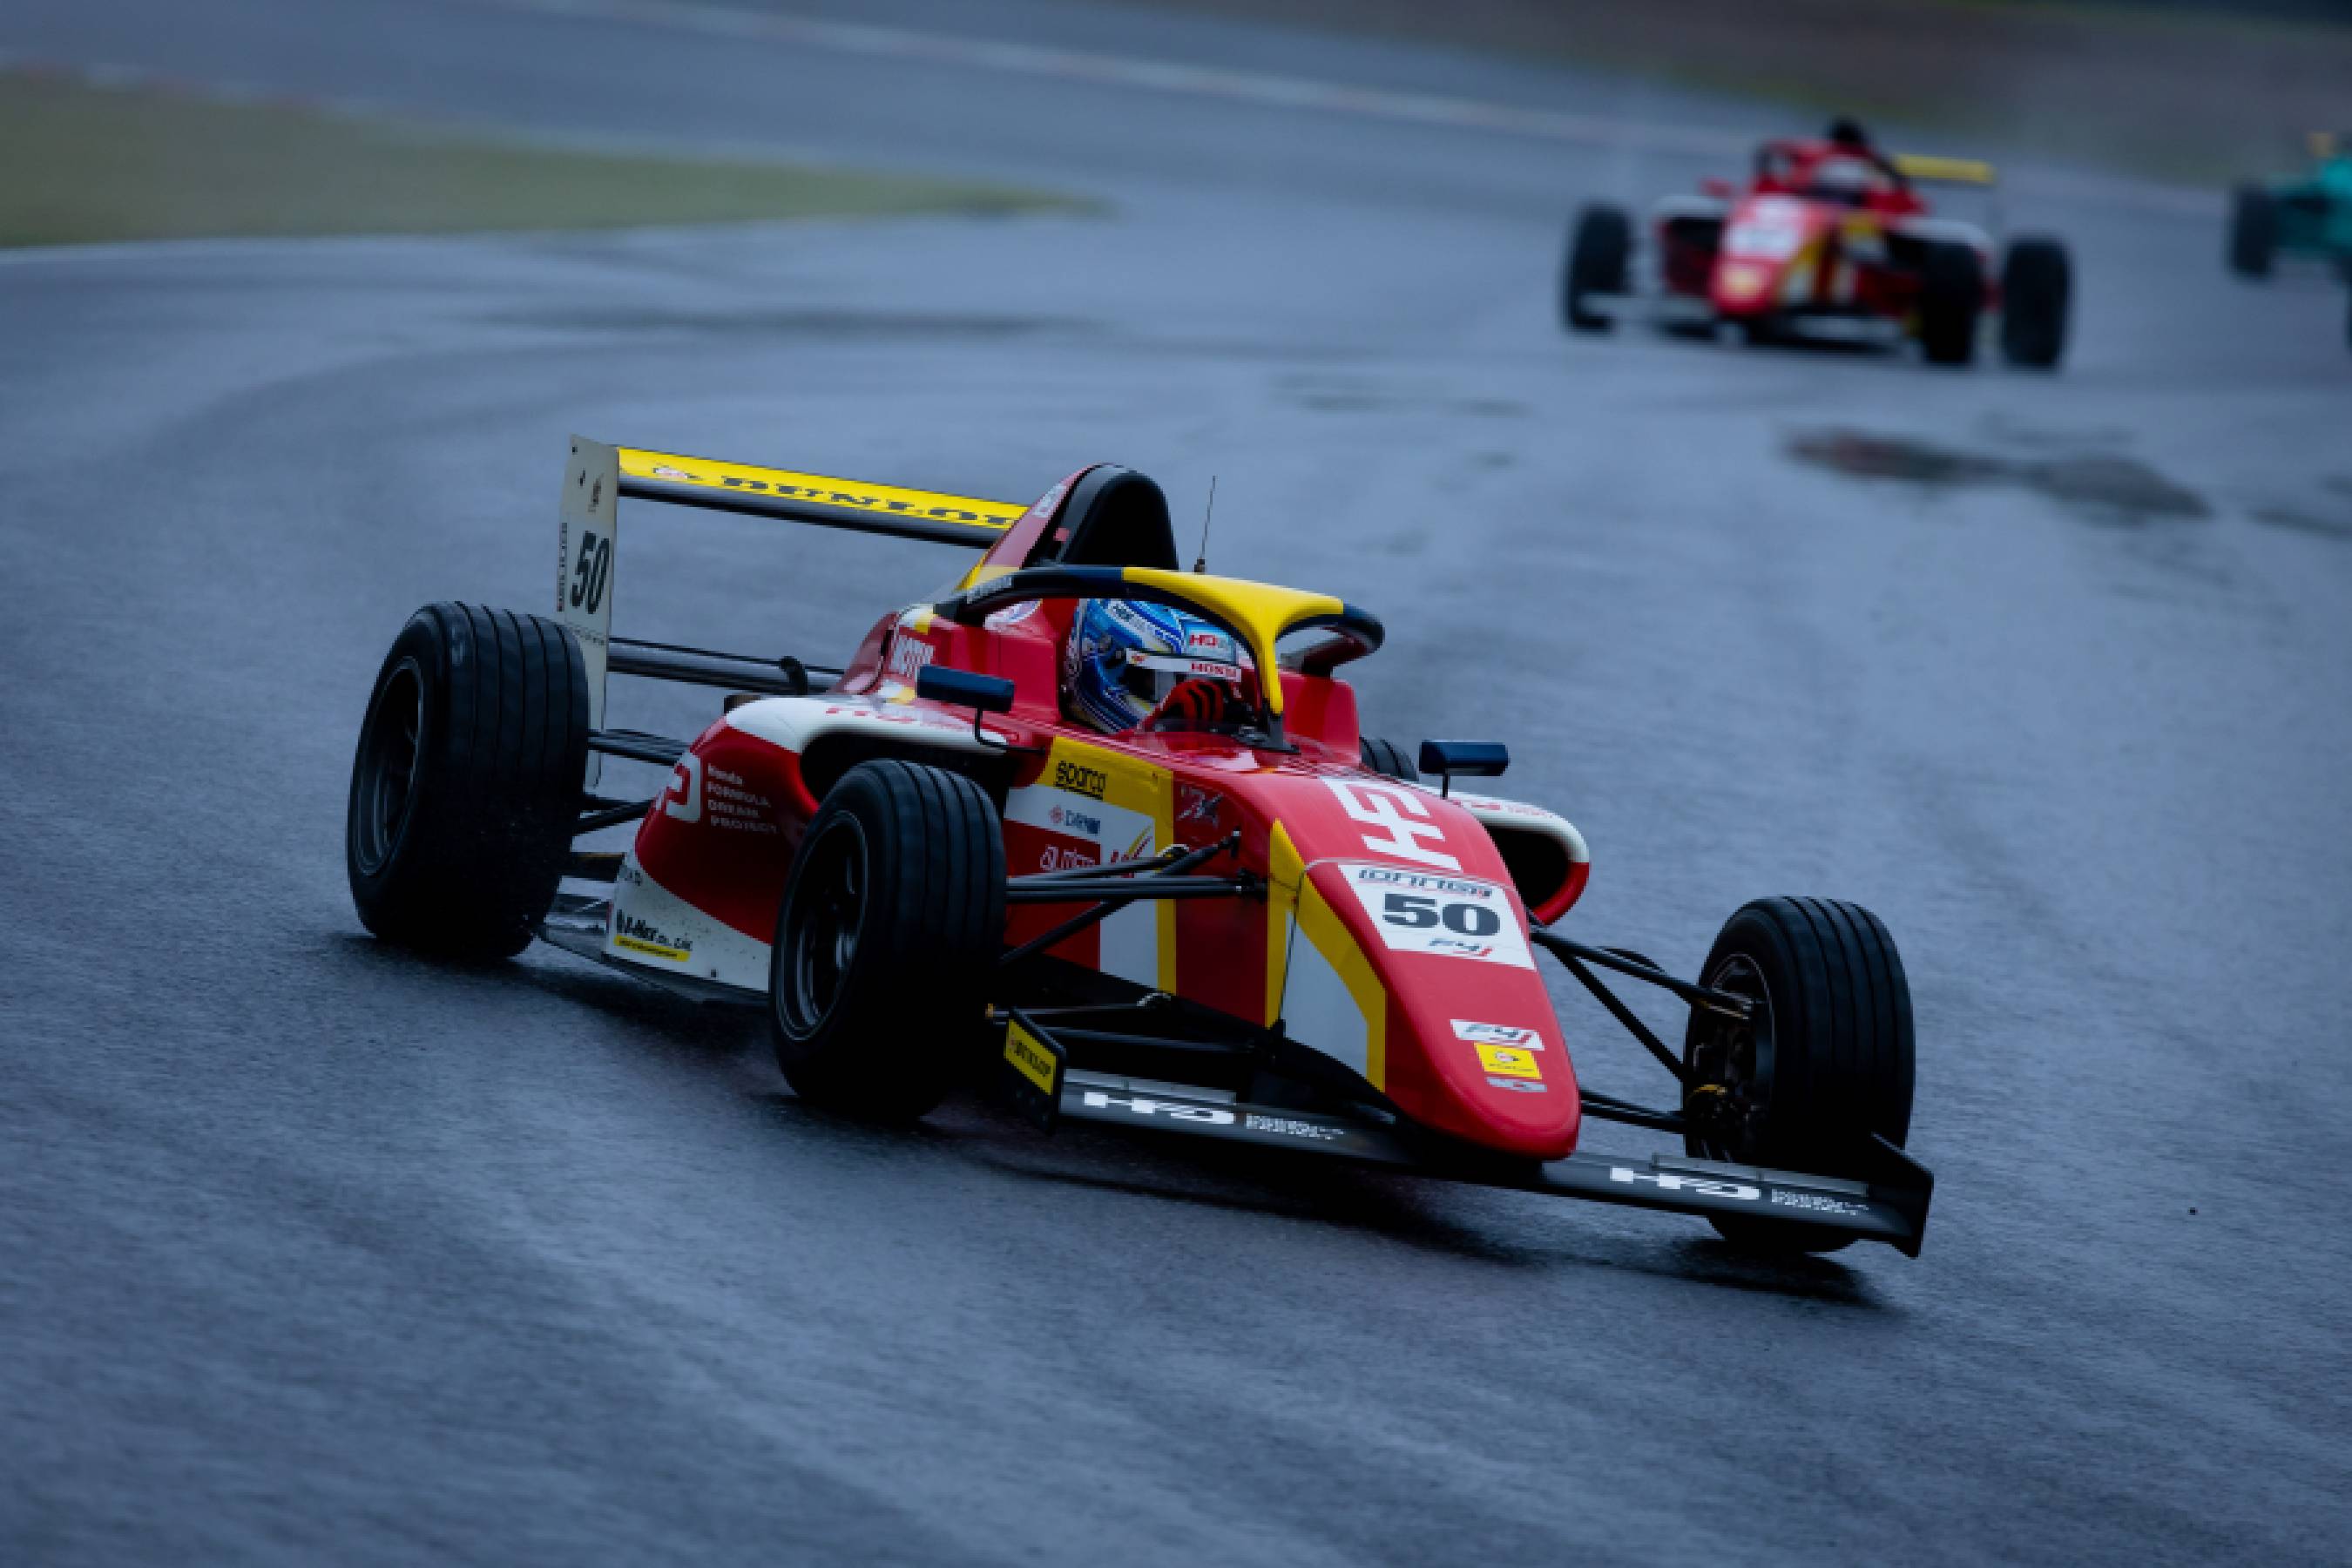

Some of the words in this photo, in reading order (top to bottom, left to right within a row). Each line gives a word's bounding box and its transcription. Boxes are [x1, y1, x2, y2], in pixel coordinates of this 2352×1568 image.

[571, 530, 610, 615] 50
[706, 781, 771, 808] FORMULA
[706, 799, 759, 816] DREAM
[710, 816, 780, 834] PROJECT
[1382, 894, 1501, 936] 50
